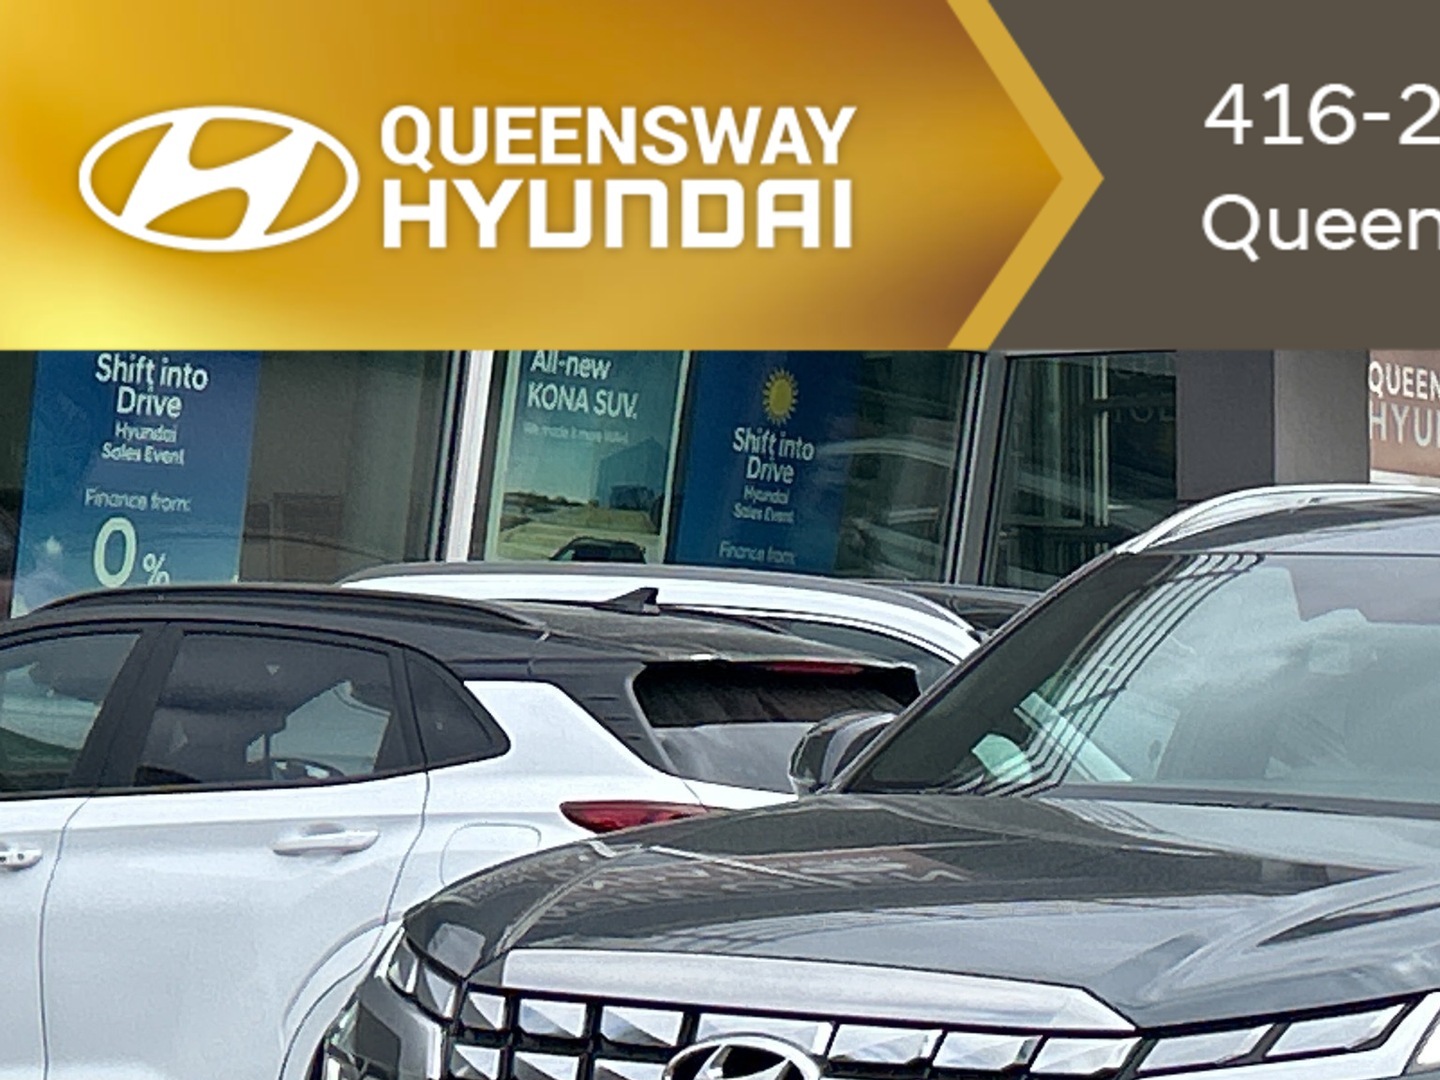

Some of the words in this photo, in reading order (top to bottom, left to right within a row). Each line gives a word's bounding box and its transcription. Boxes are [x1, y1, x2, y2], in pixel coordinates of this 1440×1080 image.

[96, 352, 156, 386] Shift
[160, 358, 208, 391] into
[530, 350, 611, 380] All-new
[117, 386, 183, 418] Drive
[527, 381, 589, 413] KONA
[115, 421, 178, 443] Hyundai
[733, 427, 777, 455] Shift
[779, 431, 817, 461] into
[746, 455, 795, 484] Drive
